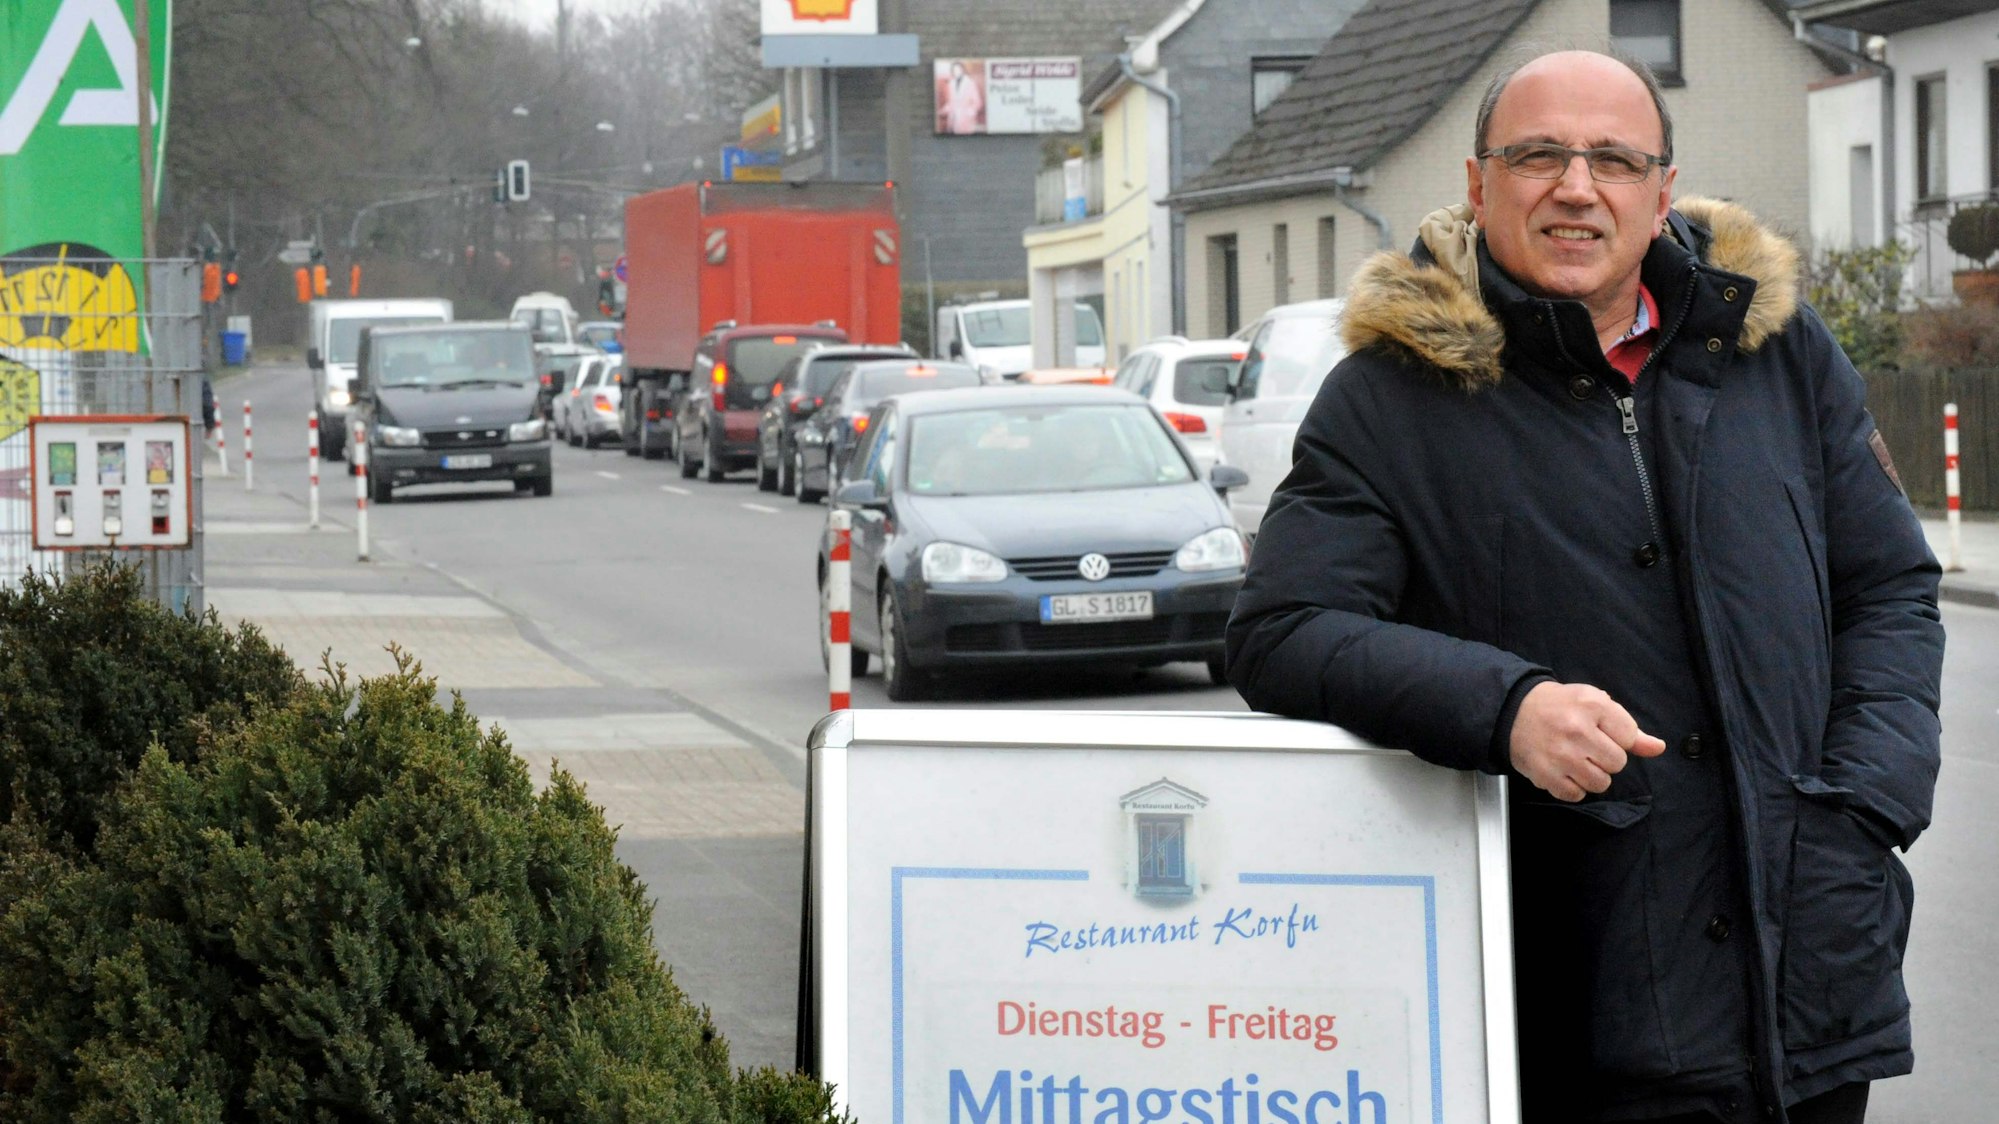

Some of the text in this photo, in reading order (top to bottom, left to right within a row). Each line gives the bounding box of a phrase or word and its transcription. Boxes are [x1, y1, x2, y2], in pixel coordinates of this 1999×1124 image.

[1105, 595, 1149, 614] 1817
[1132, 802, 1173, 810] Restaurant
[1025, 903, 1320, 958] Restaurant Korfu
[997, 1001, 1166, 1049] Dienstag
[1208, 1004, 1339, 1051] Freitag
[949, 1069, 1387, 1124] Mittagstisch
